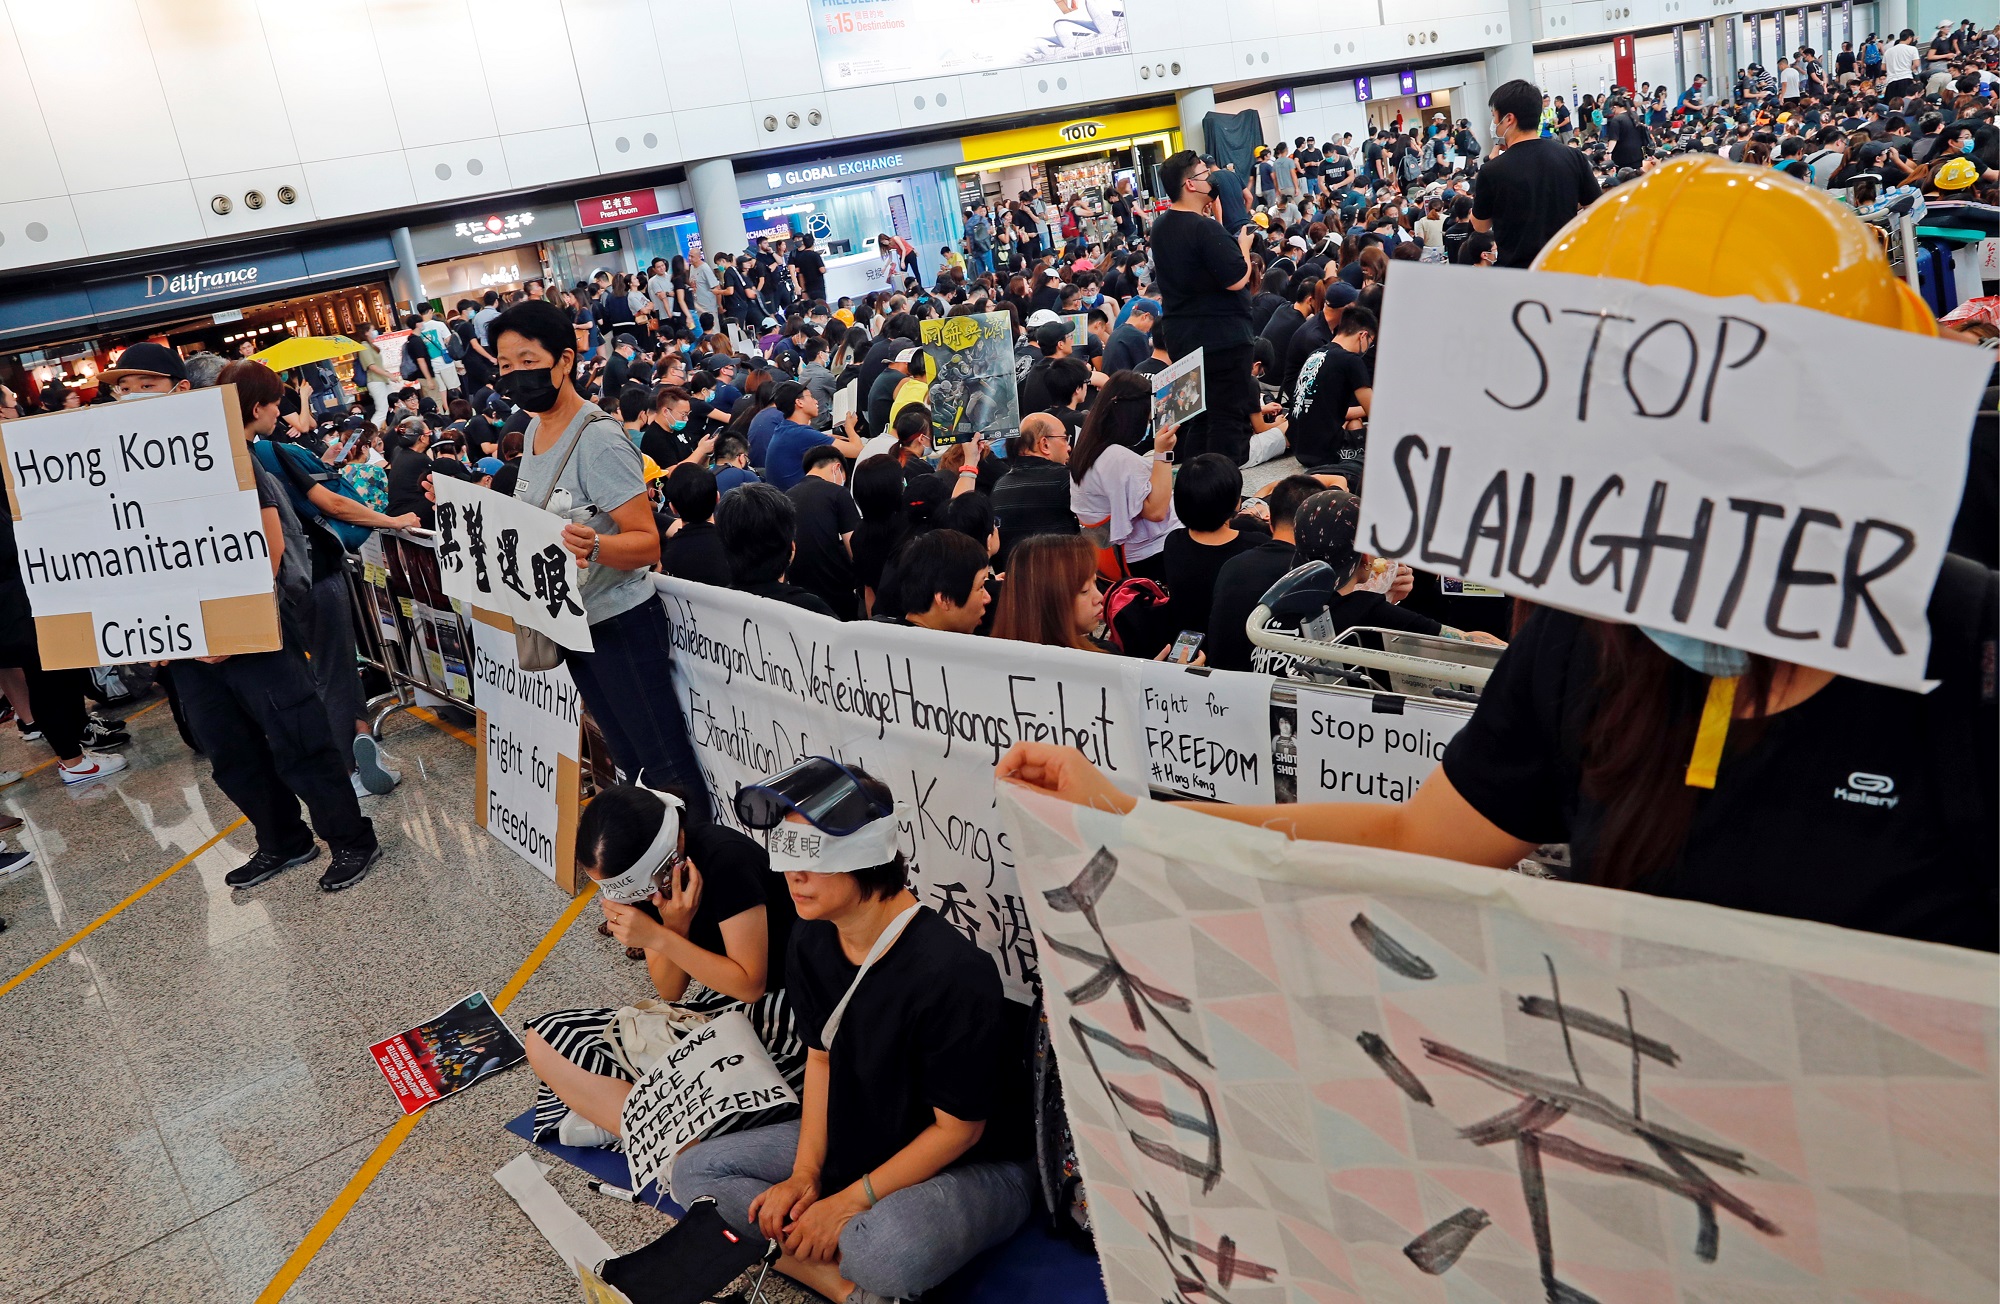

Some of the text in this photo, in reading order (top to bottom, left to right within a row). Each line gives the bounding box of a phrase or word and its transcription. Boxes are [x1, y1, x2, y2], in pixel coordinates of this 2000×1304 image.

[827, 19, 905, 35] To Destinations
[834, 12, 854, 33] 15
[785, 154, 903, 185] GLOBAL EXCHANGE
[600, 207, 638, 218] Press Room
[602, 196, 632, 210] 記者室
[144, 266, 258, 298] Délifrance
[1484, 299, 1768, 423] STOP
[14, 431, 214, 487] Hong Kong
[110, 493, 145, 531] in
[24, 526, 268, 585] Humanitarian
[437, 501, 585, 619] 黑警還眼
[1371, 434, 1916, 656] SLAUGHTER
[102, 615, 192, 658] Crisis
[476, 645, 516, 695] Stand
[518, 671, 552, 713] with
[555, 679, 579, 727] HK
[789, 632, 894, 740] Verteidige
[886, 653, 1012, 766] Hongkongs
[1144, 687, 1230, 724] Fight for
[489, 723, 554, 793] Fight for
[1145, 726, 1259, 786] FREEDOM
[1275, 752, 1298, 764] SHOT
[1311, 710, 1447, 760] Stop polic
[1151, 761, 1217, 797] #Hong Kong
[1276, 764, 1298, 776] SHOT
[490, 789, 553, 868] Freedom
[602, 875, 636, 890] POLICE
[623, 1026, 716, 1119] HONG KONG
[625, 1070, 685, 1132] POLICE
[627, 1054, 745, 1153] ATTEMPT TO
[632, 1086, 714, 1168] MURDER
[635, 1085, 787, 1188] HK CITIZENS
